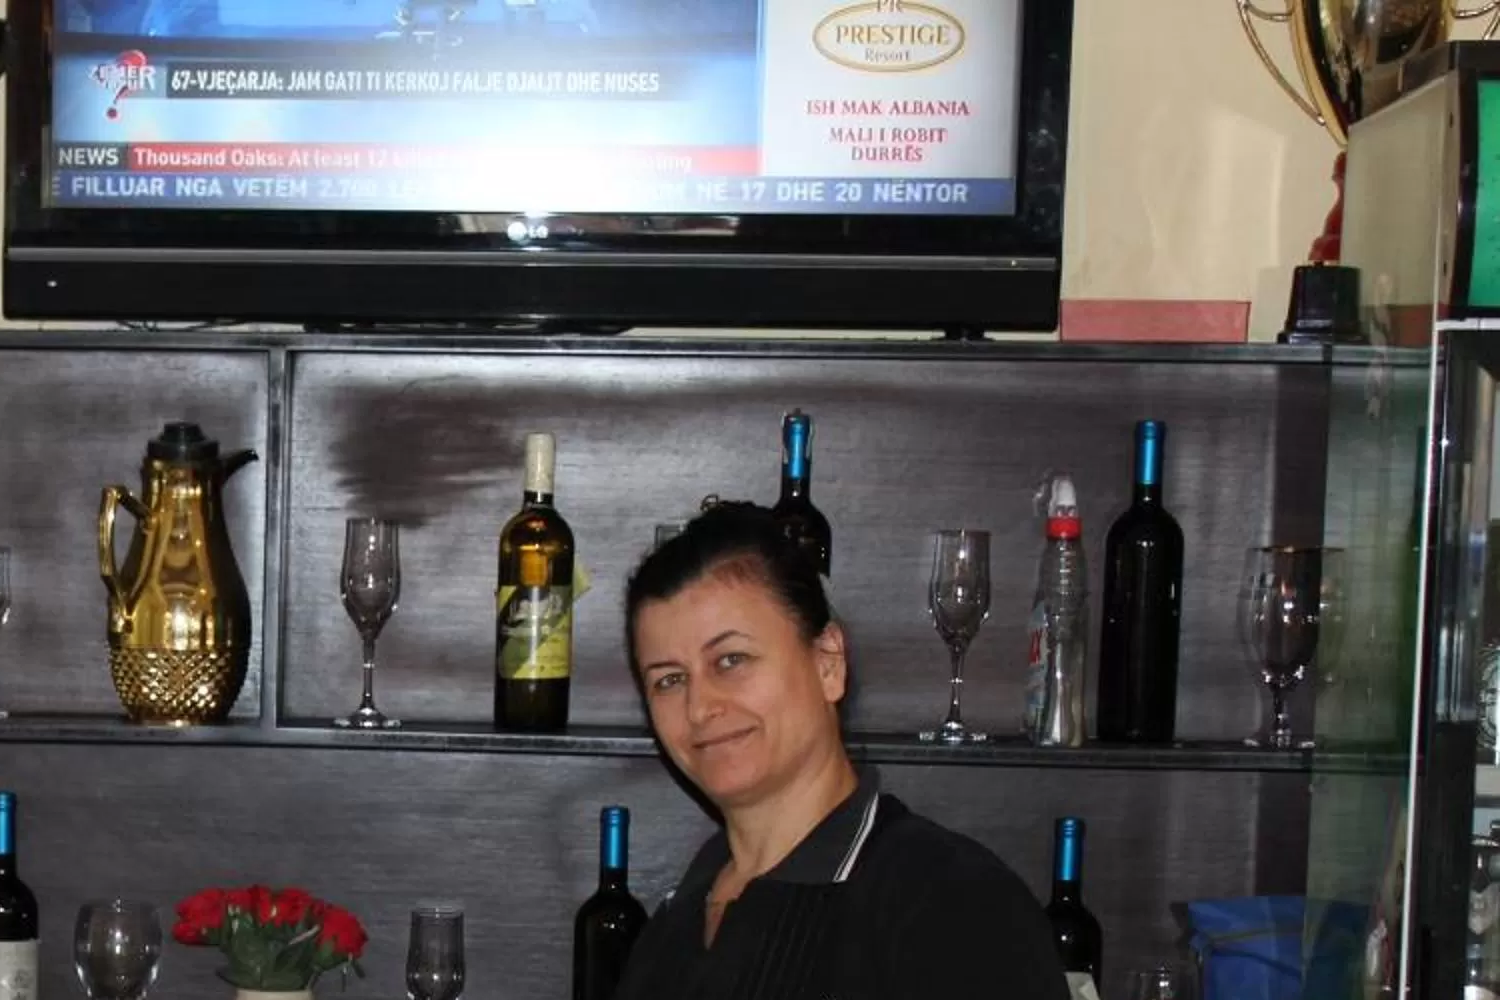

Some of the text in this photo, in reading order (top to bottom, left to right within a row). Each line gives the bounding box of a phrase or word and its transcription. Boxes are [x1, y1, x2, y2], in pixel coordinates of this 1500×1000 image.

[835, 24, 951, 45] PRESTIGE
[864, 48, 912, 63] Resort
[287, 71, 322, 92] JAM
[325, 71, 361, 92] GATI
[366, 71, 381, 92] TI
[566, 72, 600, 93] DHE
[603, 72, 661, 94] NUSES
[806, 100, 971, 117] ISH MAK ALBANIA
[830, 127, 873, 142] MALI
[891, 127, 948, 144] ROBIT
[58, 148, 119, 166] NEWS
[134, 147, 226, 167] Thousand
[231, 148, 285, 167] Oaks:
[288, 148, 309, 167] At
[71, 176, 166, 197] FILLUAR
[175, 177, 224, 197] NGA
[741, 181, 766, 201] 17
[776, 181, 826, 202] DHE
[834, 182, 862, 203] 20
